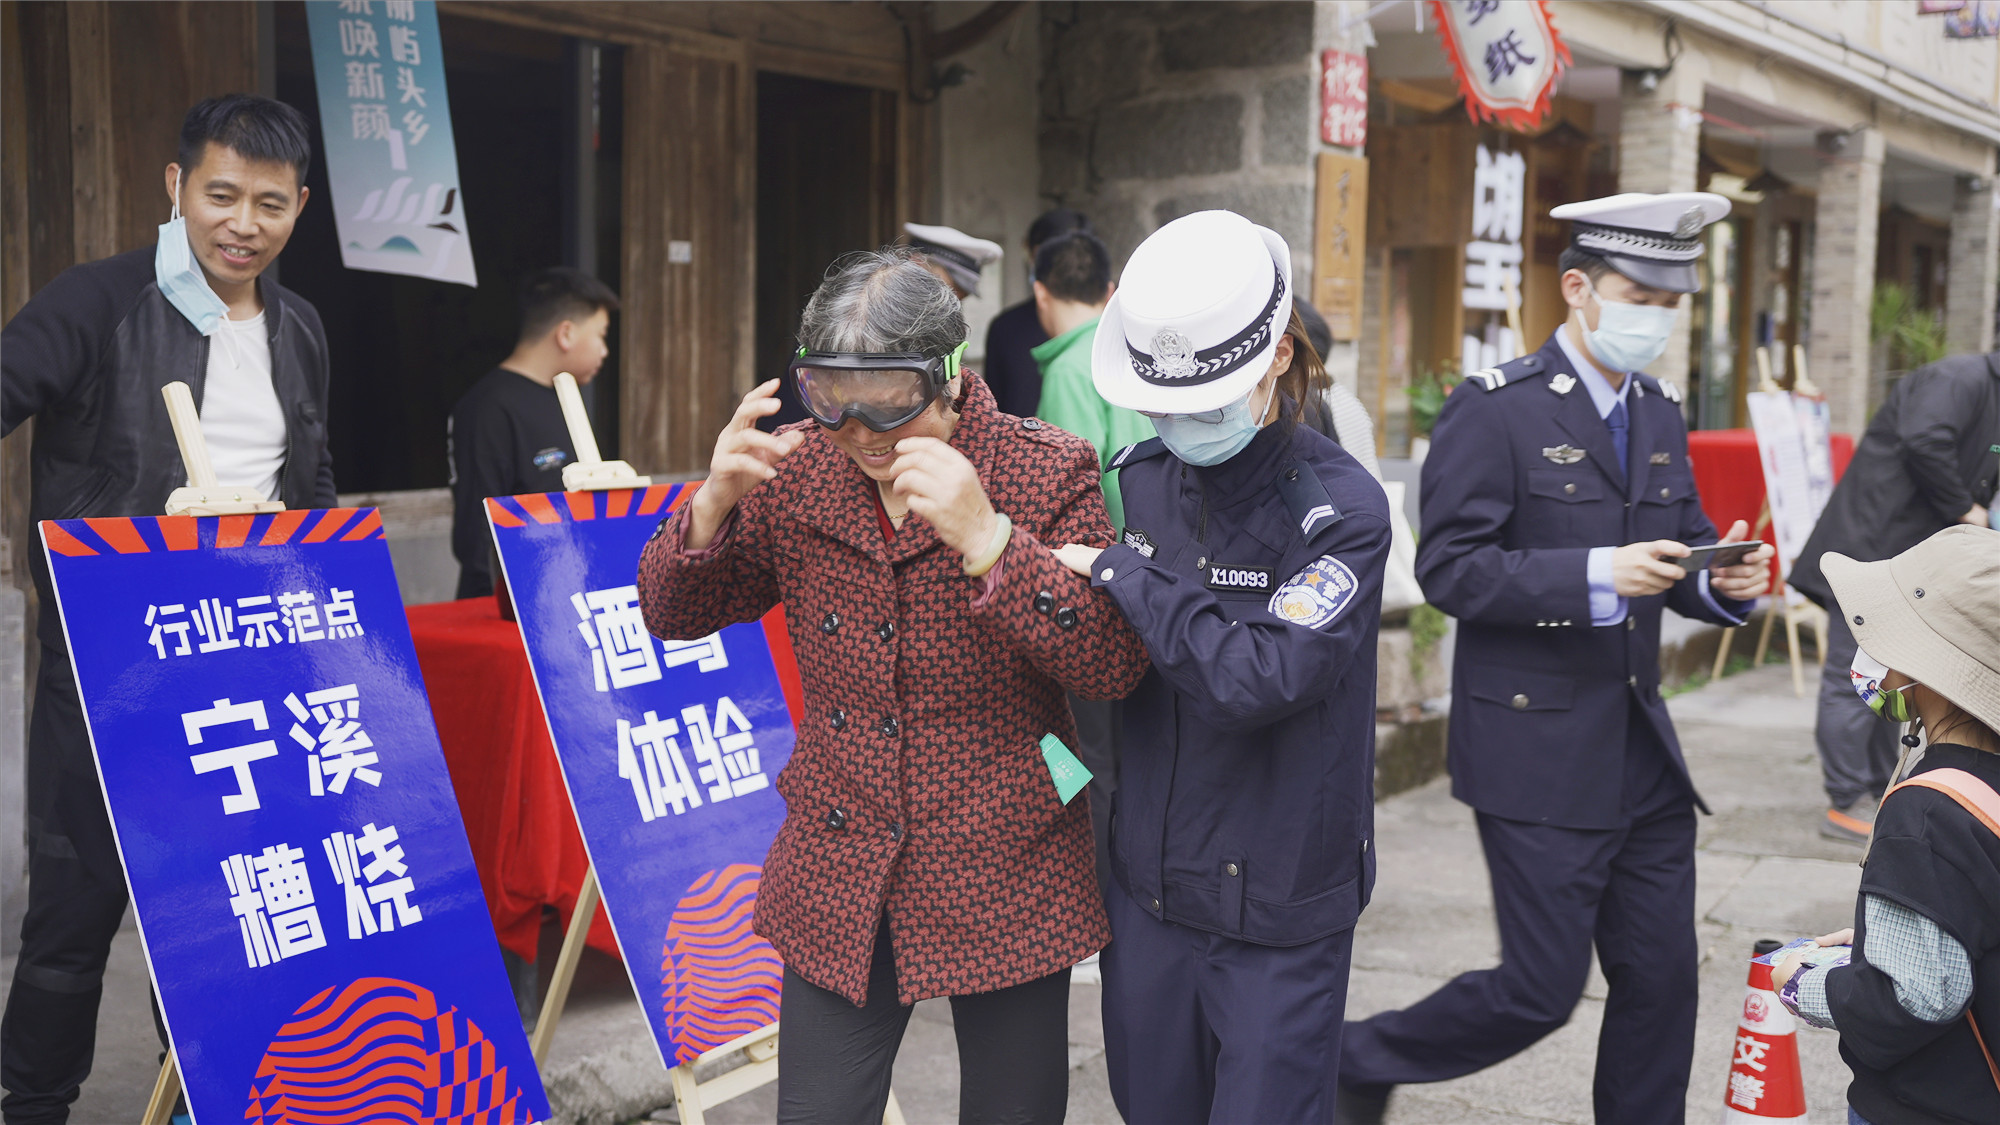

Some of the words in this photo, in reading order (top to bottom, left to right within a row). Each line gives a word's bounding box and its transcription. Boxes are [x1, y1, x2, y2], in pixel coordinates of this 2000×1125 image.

[144, 587, 365, 660] 行业示范点
[1210, 567, 1269, 588] X10093
[181, 683, 383, 816] 宁溪
[616, 696, 770, 823] 体验
[220, 822, 424, 969] 糟烧
[1729, 1035, 1771, 1112] 交警
